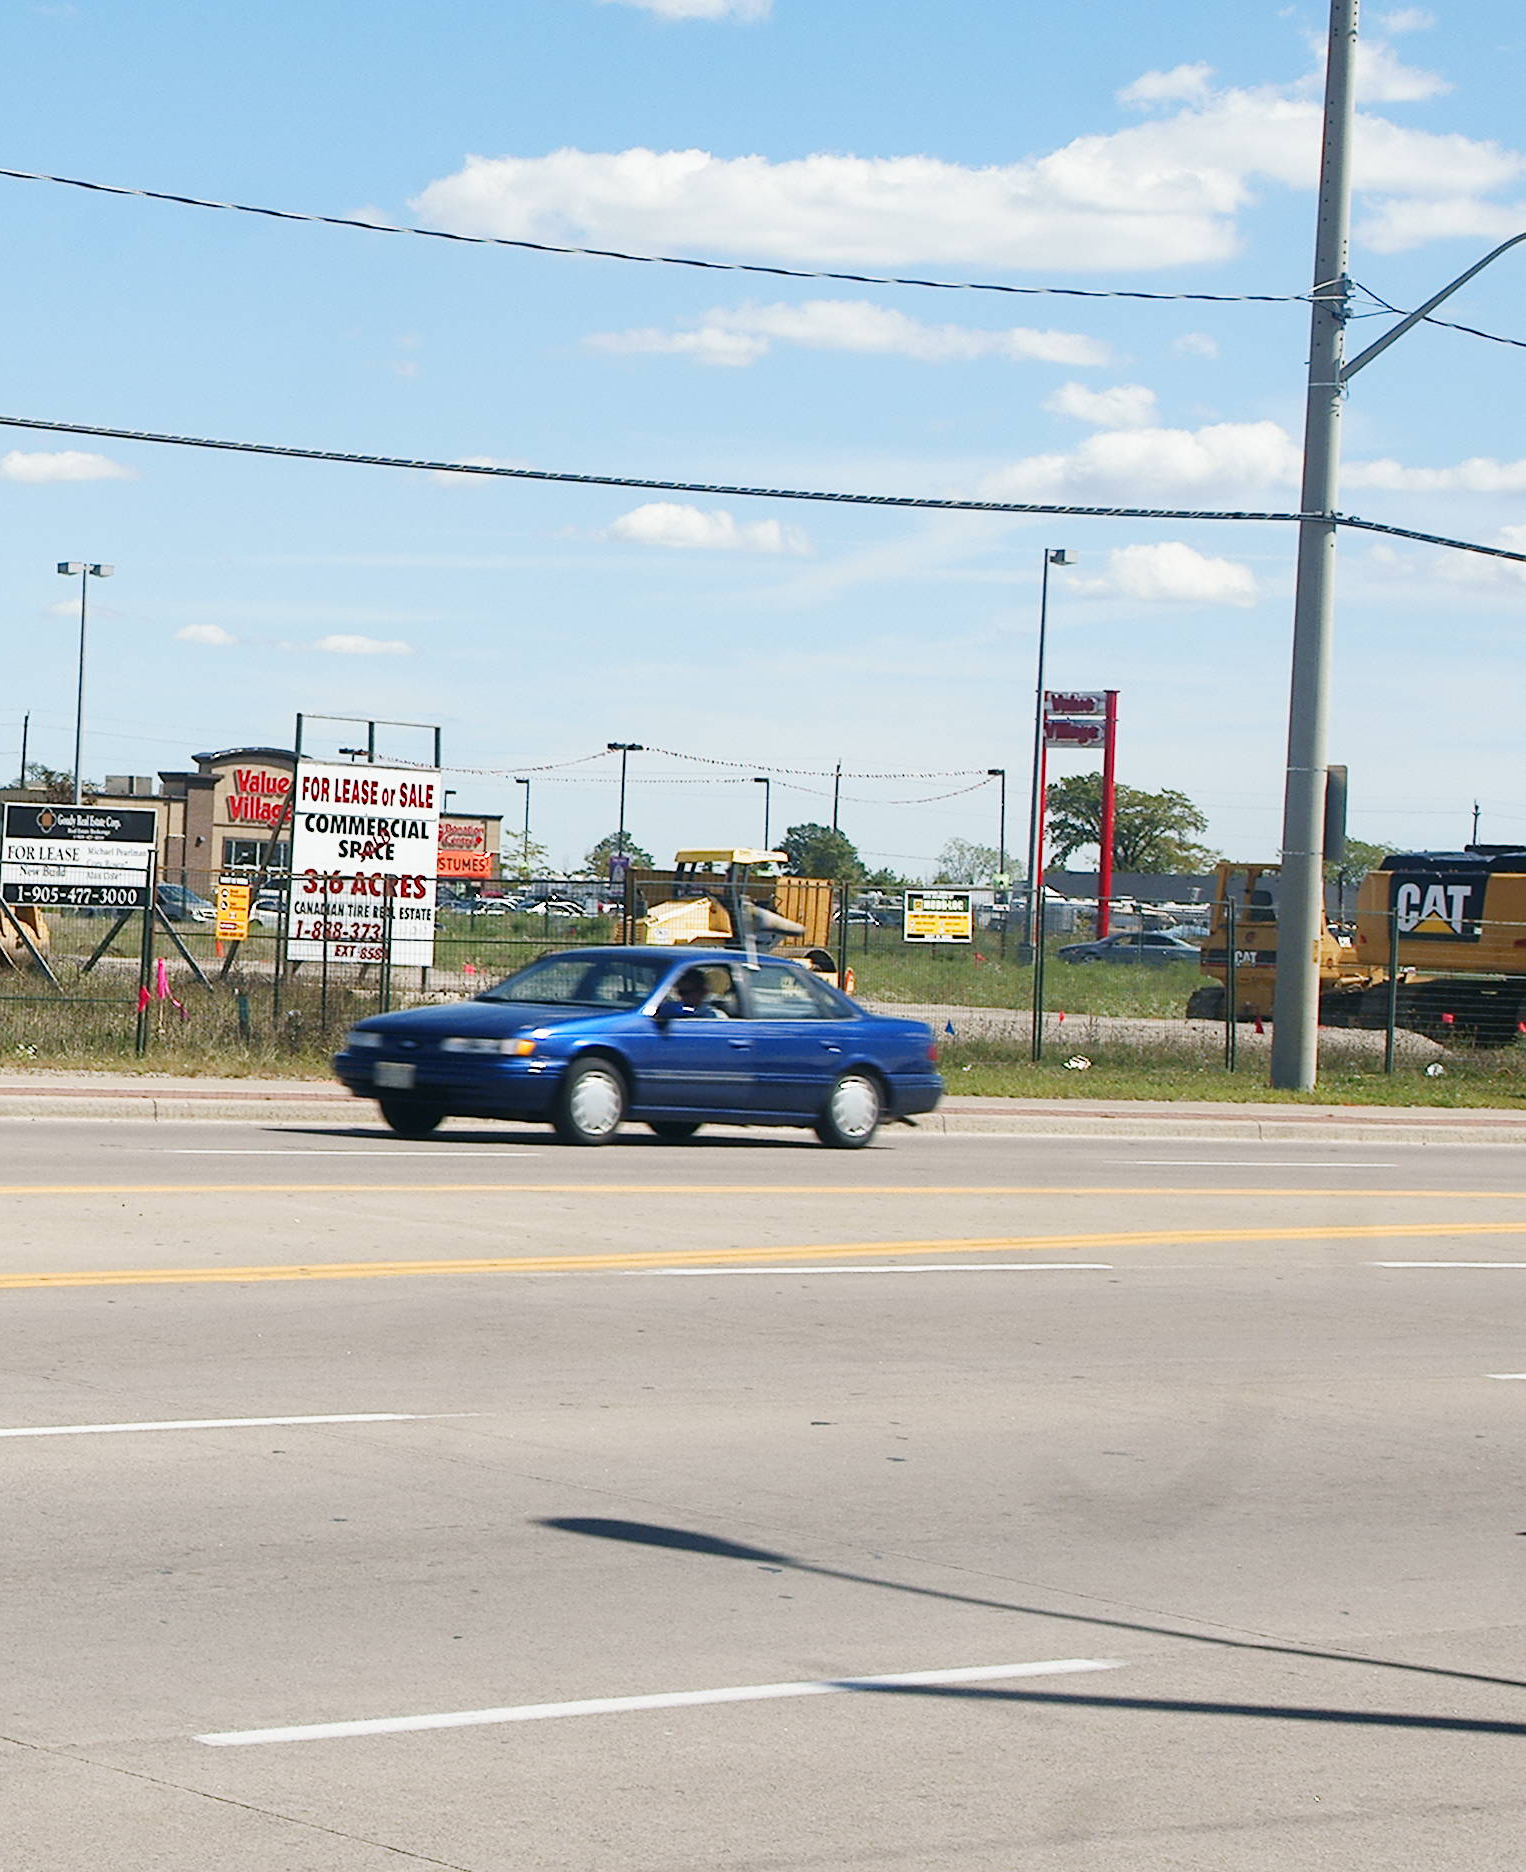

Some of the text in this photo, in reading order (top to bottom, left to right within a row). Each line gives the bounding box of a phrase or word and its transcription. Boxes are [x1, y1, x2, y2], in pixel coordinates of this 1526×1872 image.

[236, 769, 290, 795] Value
[302, 776, 434, 809] FOR LEASE or SALE
[305, 813, 430, 840] COMMERCIAL
[7, 845, 80, 861] FOR LEASE
[338, 839, 395, 861] SPACE
[19, 864, 40, 877] New
[17, 885, 138, 905] 1-905-477-3000
[350, 871, 427, 900] ACRES
[347, 903, 370, 918] TIRE
[399, 907, 431, 921] ESTATE
[1397, 883, 1472, 934] CAT
[335, 945, 357, 958] EXT
[1234, 951, 1257, 967] CAT
